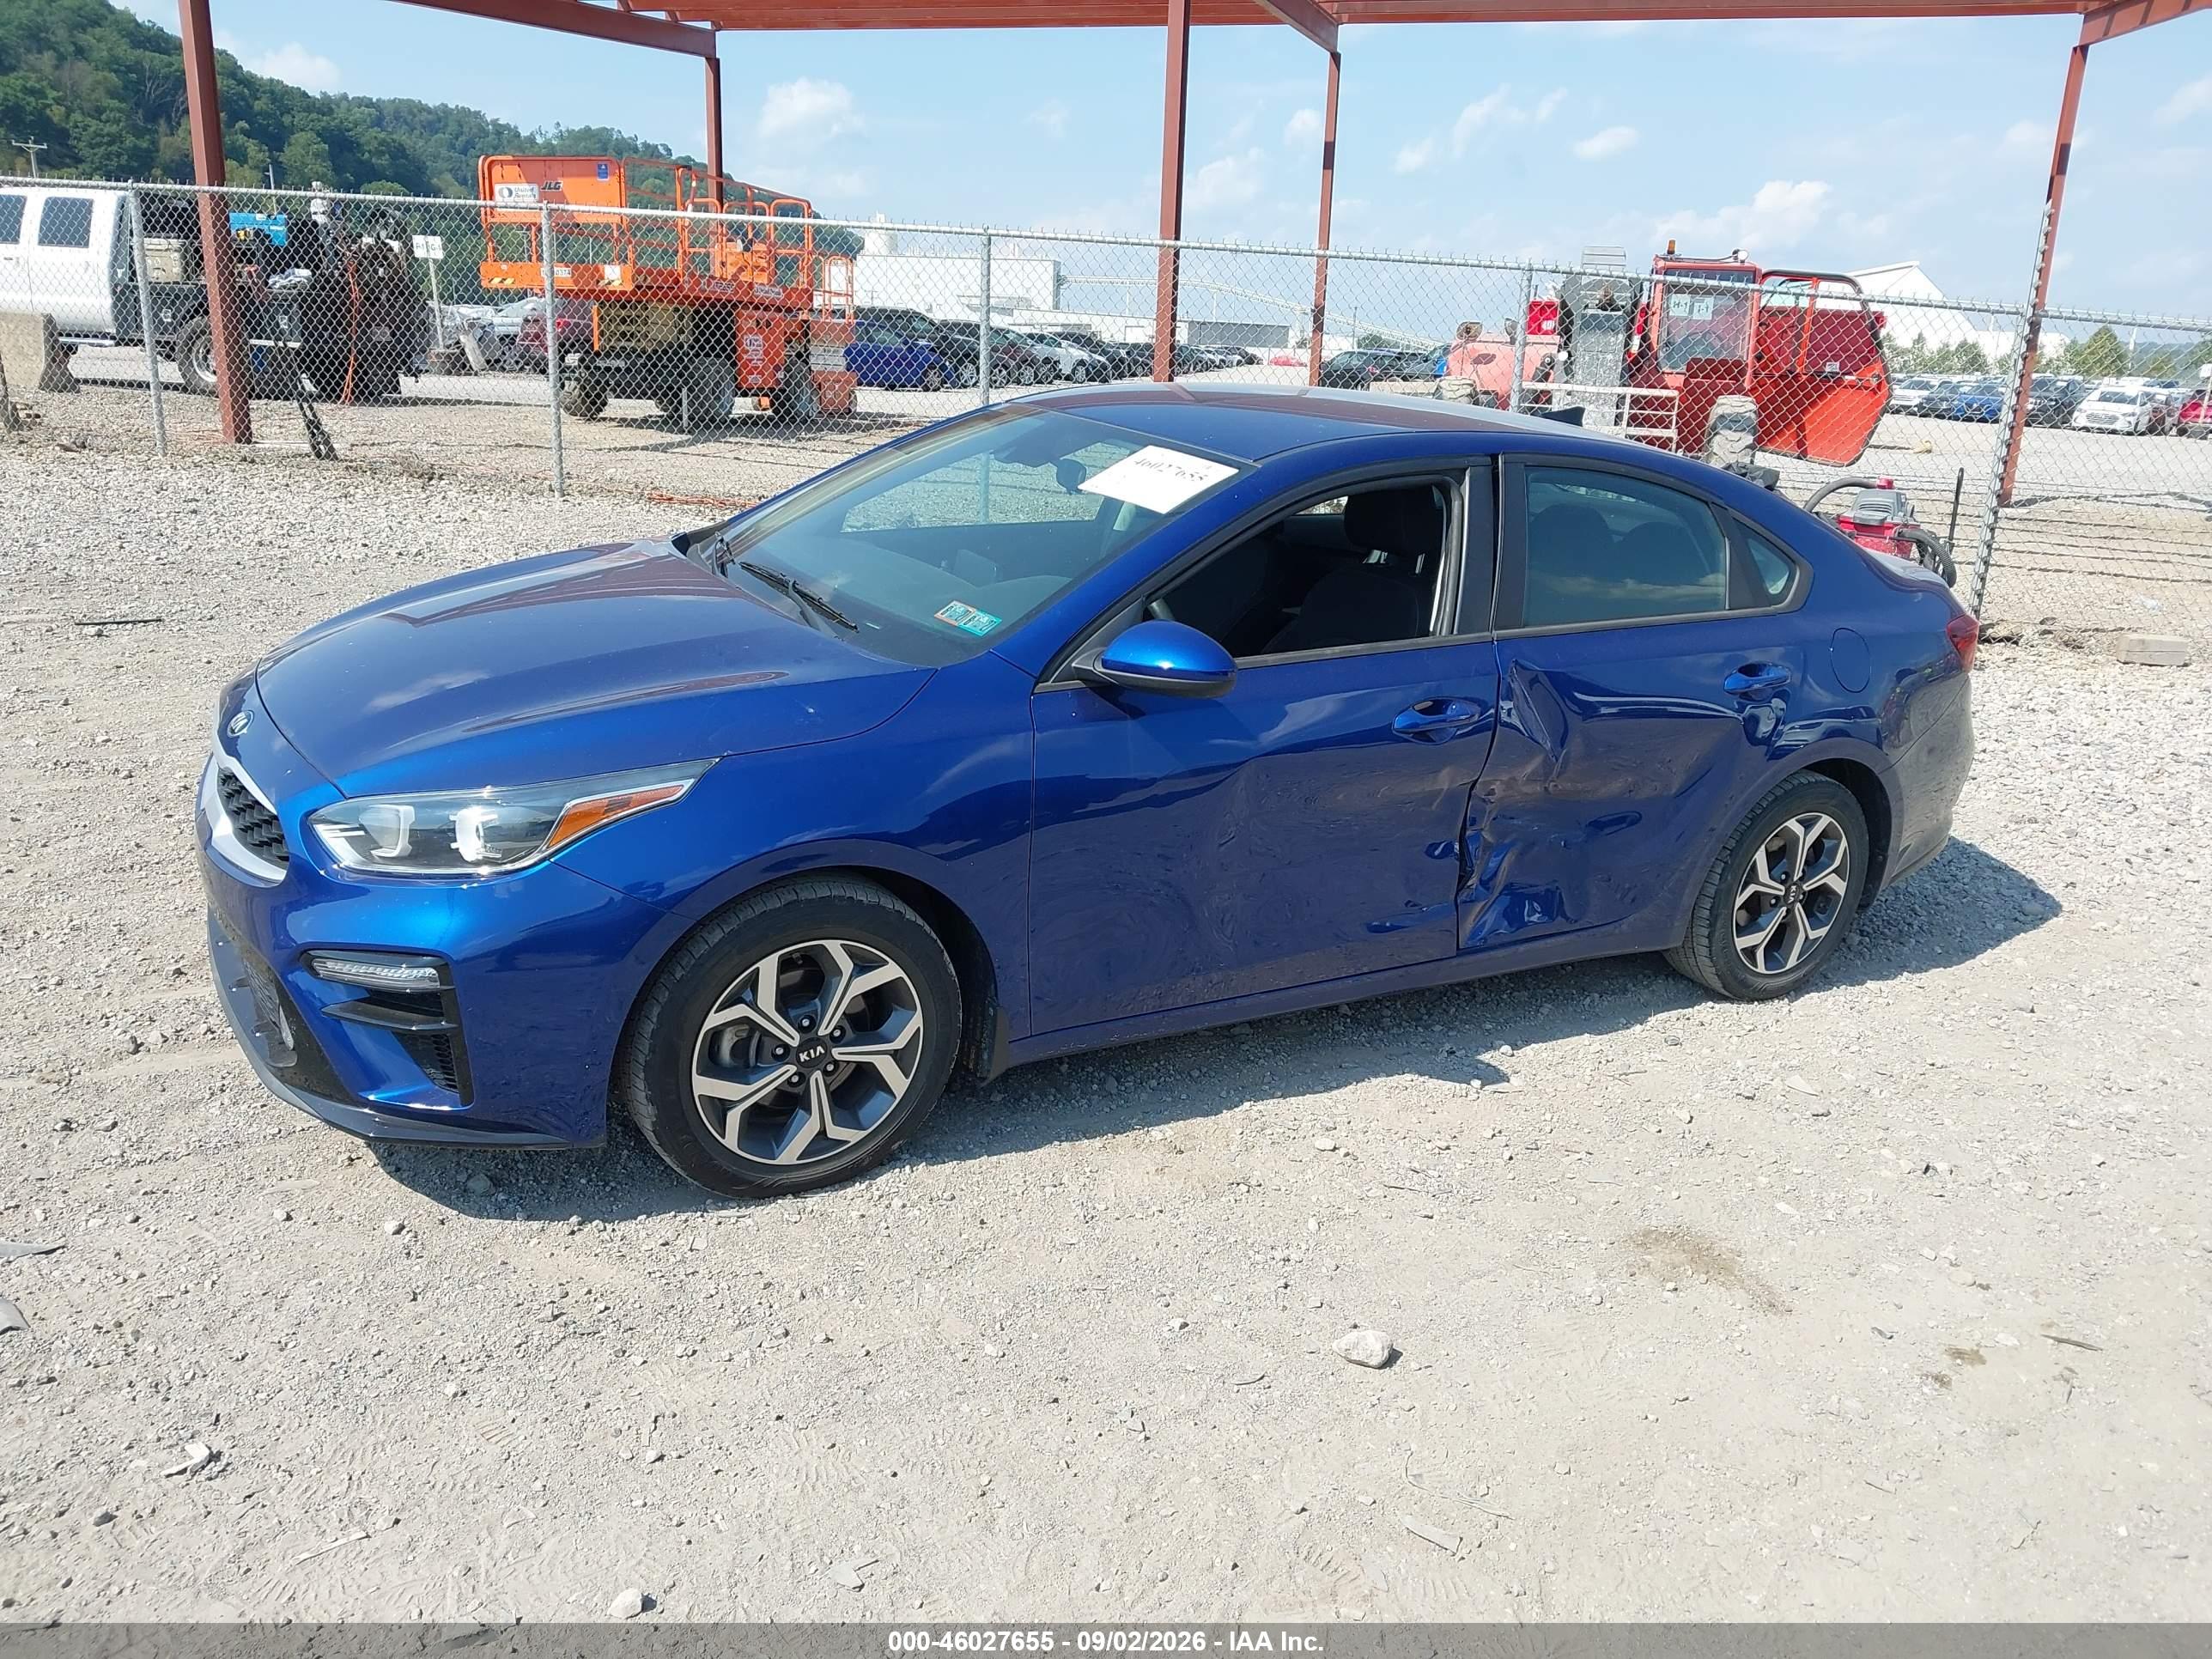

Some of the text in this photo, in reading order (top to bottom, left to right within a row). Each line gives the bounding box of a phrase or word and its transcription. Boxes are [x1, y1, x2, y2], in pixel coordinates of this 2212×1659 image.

[540, 180, 562, 191] JLG
[1787, 885, 1797, 904] KIA
[799, 1045, 825, 1063] KIA
